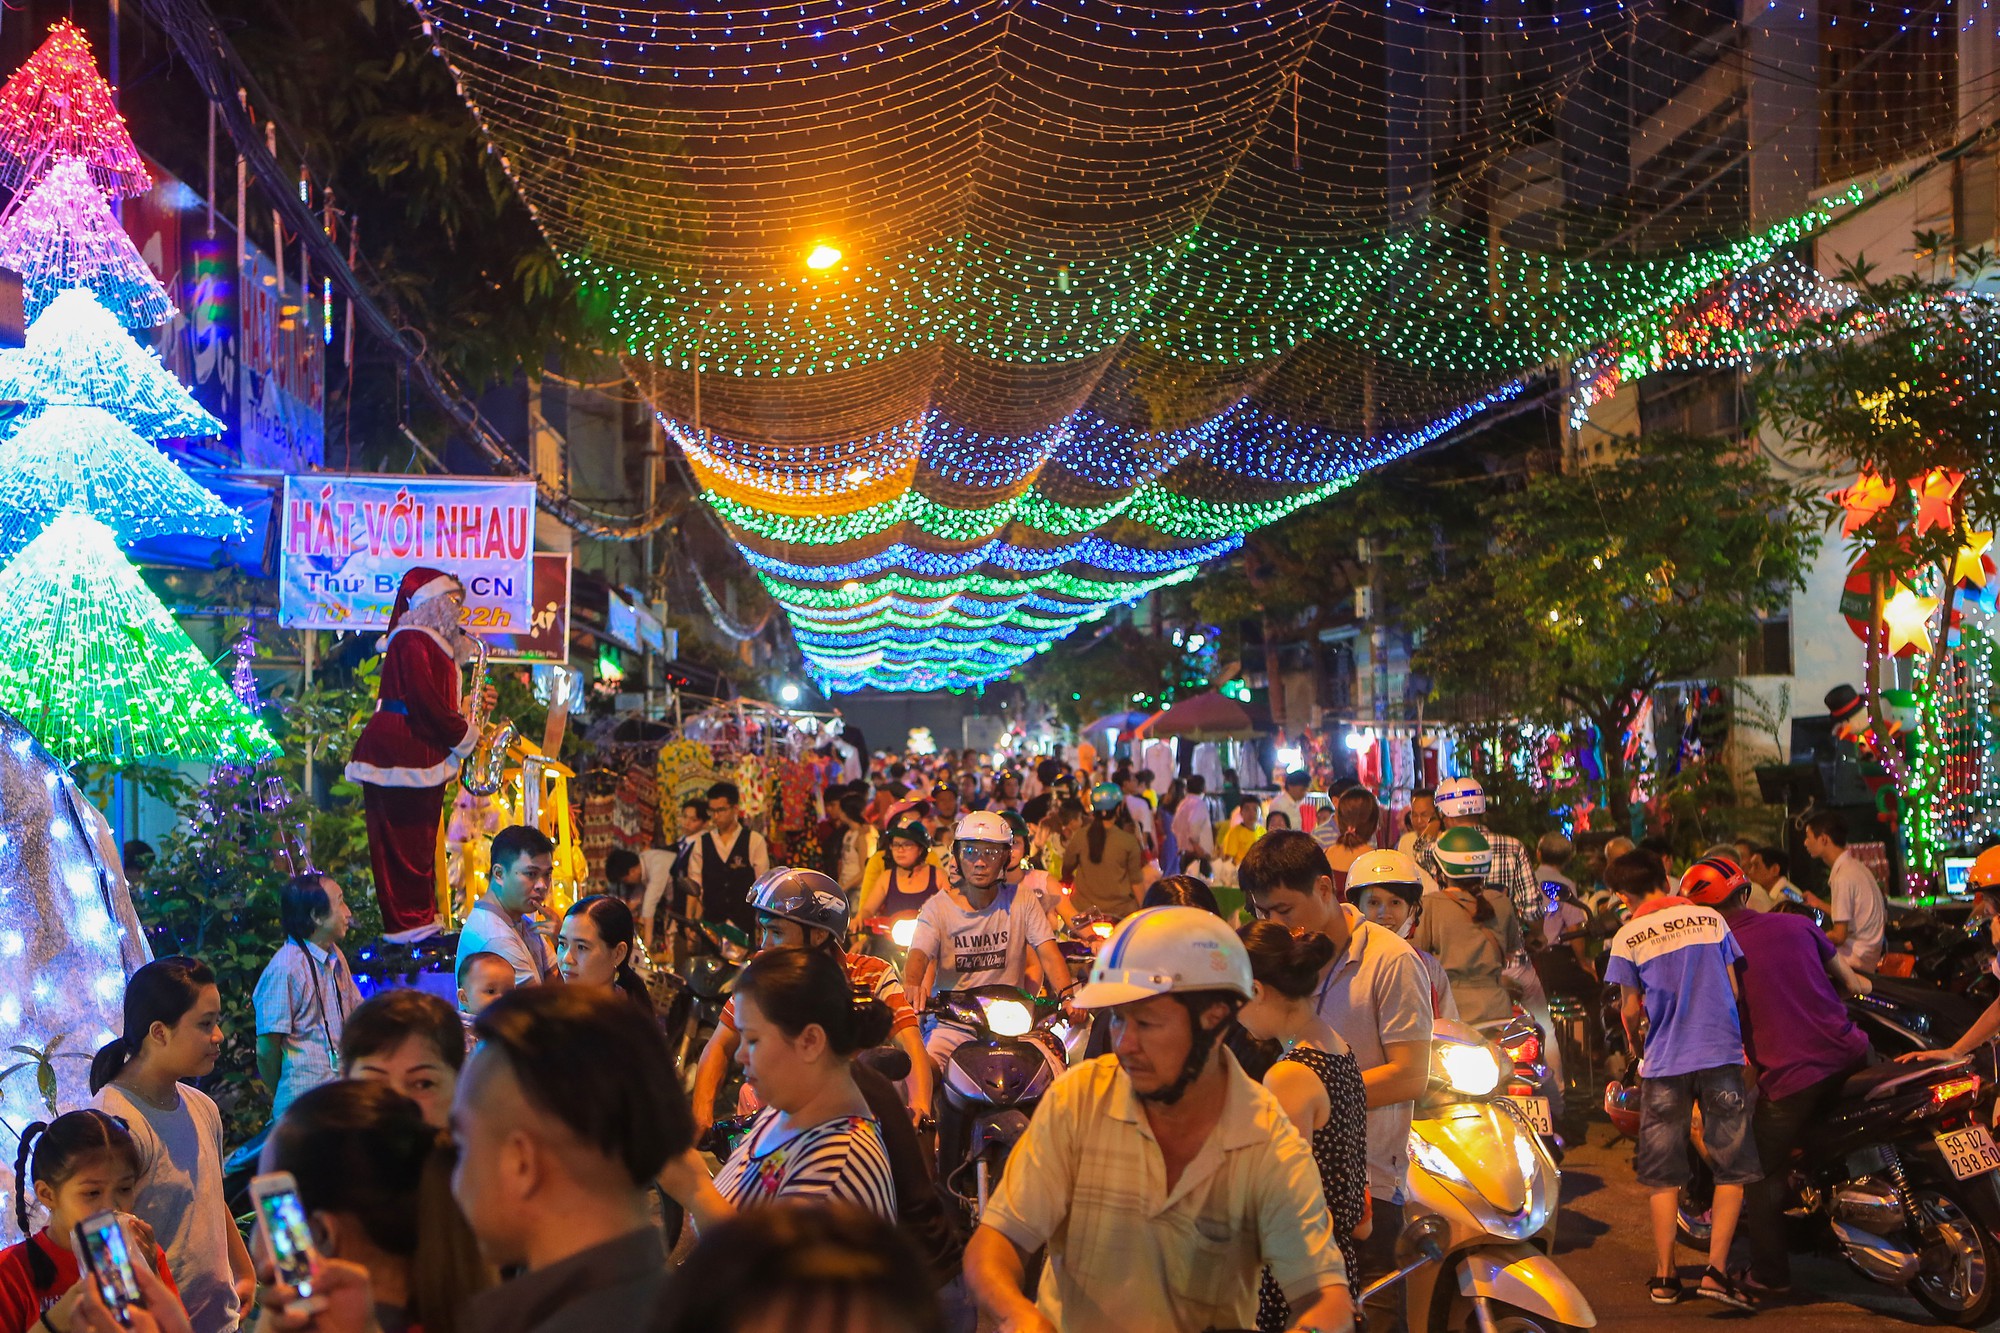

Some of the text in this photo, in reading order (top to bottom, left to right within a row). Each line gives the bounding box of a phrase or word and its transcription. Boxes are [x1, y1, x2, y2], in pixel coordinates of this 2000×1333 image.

[289, 483, 528, 560] HÁT VỚI NHAU
[304, 573, 364, 593] Thứ
[471, 577, 513, 597] CN
[305, 602, 352, 624] Từ
[955, 931, 1008, 948] ALWAYS
[1626, 916, 1718, 949] SEA SCAPE
[1651, 932, 1681, 946] ROWING
[1945, 1130, 1987, 1155] 59-D2
[1952, 1147, 2000, 1177] 298.60
